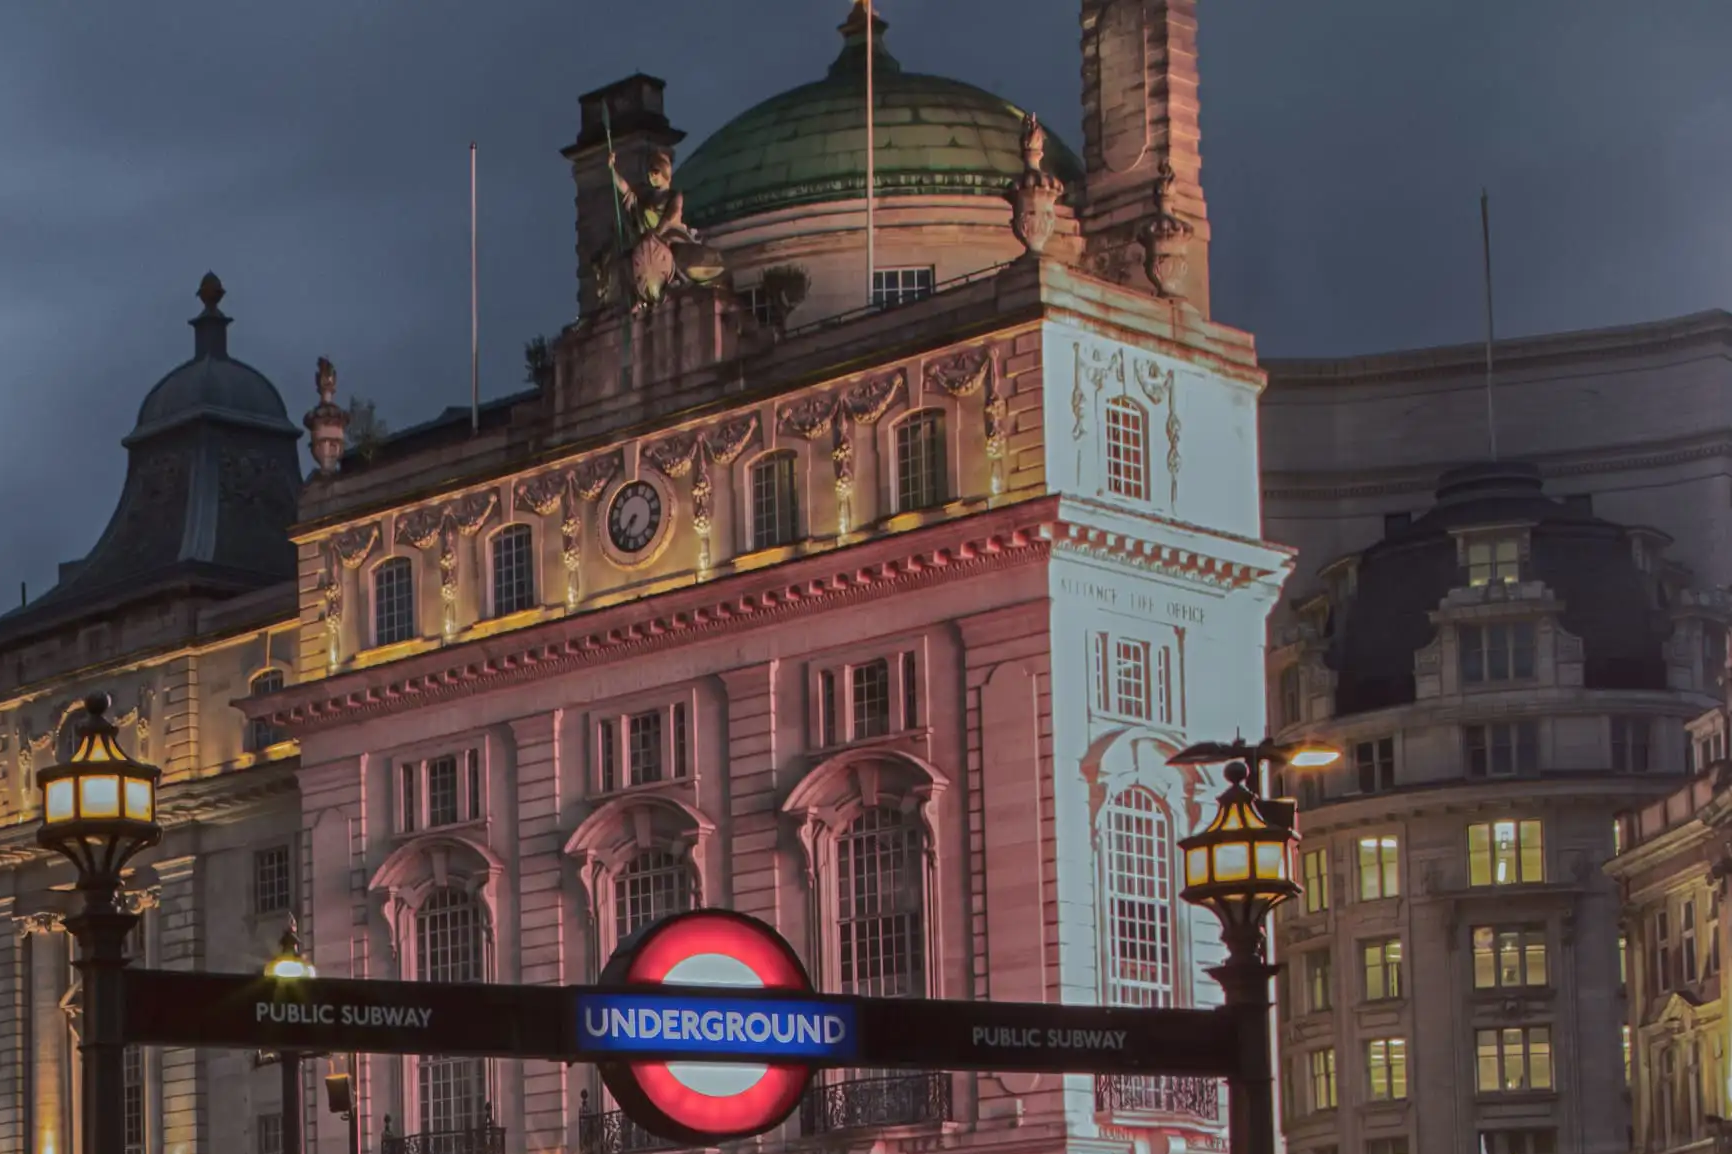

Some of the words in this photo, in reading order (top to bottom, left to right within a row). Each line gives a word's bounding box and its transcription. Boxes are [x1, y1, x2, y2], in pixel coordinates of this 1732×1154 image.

[1060, 577, 1118, 605] ALLIANCE
[1130, 591, 1154, 613] LIFE
[1166, 601, 1205, 626] OFFICE
[255, 1002, 335, 1024] PUBLIC
[340, 1004, 433, 1029] SUBWAY
[584, 1006, 846, 1044] UNDERGROUND
[972, 1025, 1041, 1048] PUBLIC
[1047, 1027, 1127, 1050] SUBWAY
